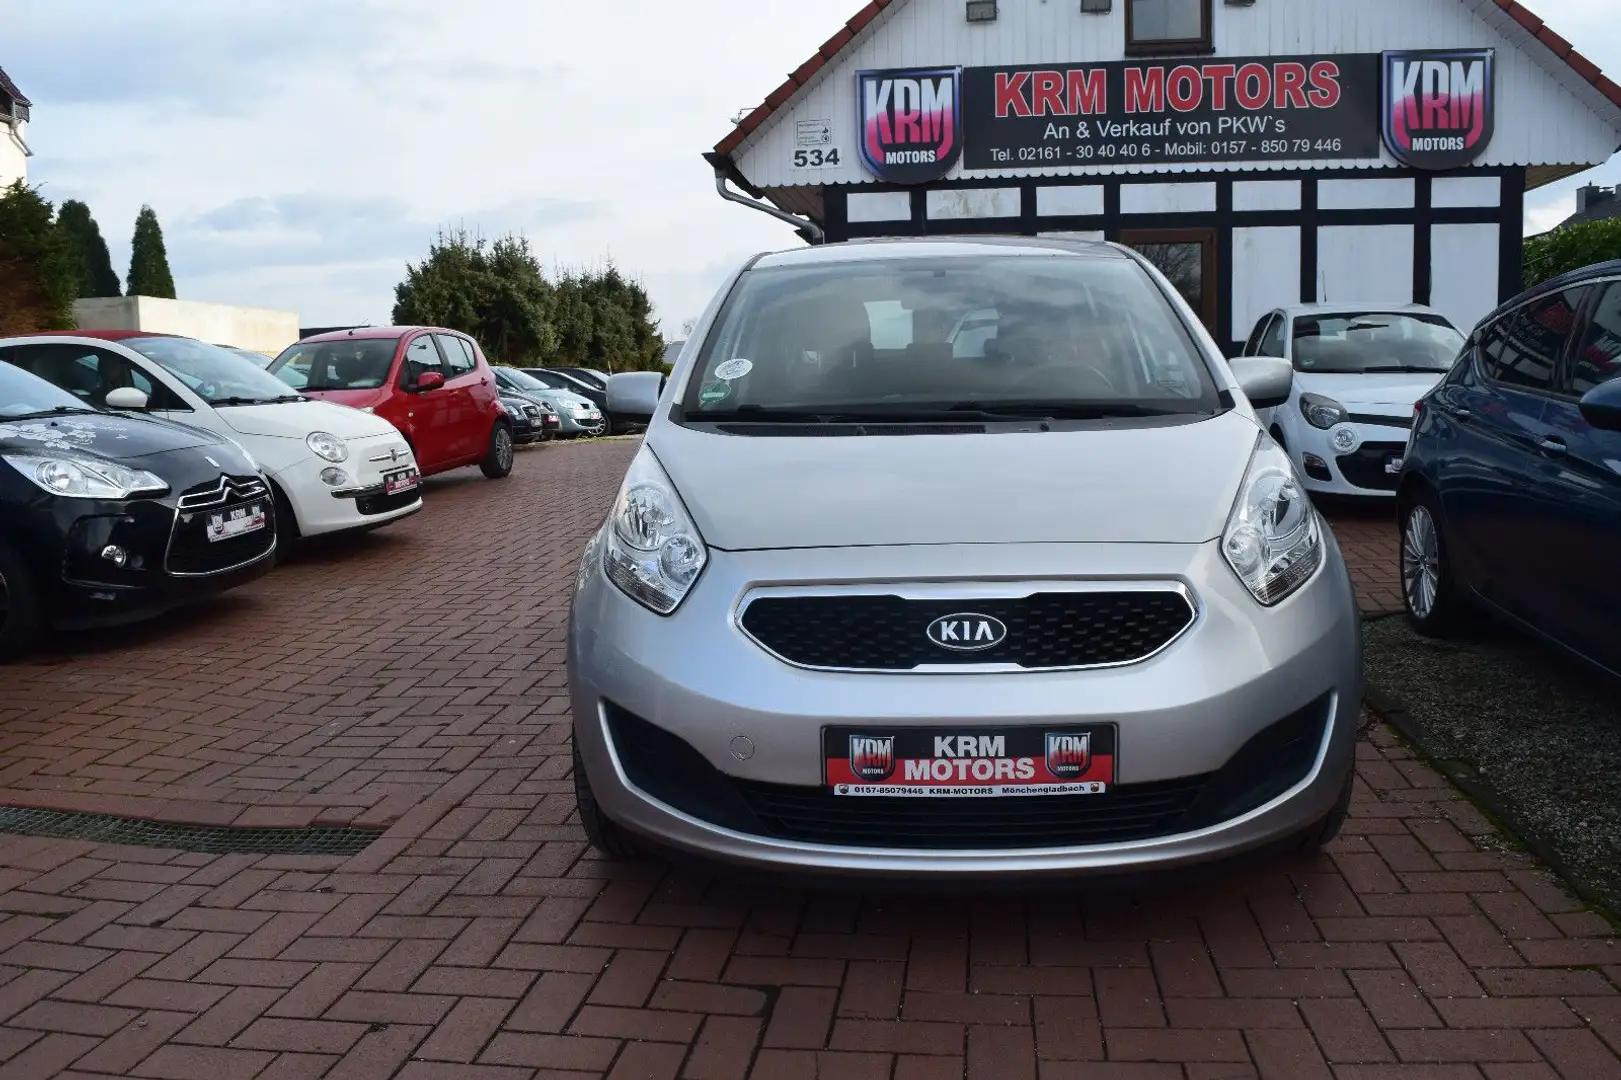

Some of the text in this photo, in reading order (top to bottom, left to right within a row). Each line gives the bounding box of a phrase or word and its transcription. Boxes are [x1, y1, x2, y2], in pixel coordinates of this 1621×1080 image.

[994, 61, 1341, 118] KRM MOTORS
[1393, 61, 1484, 149] KRM
[866, 78, 953, 161] KRM
[1043, 122, 1070, 140] An
[1076, 121, 1091, 139] &
[1097, 118, 1172, 138] Verkauf
[1176, 121, 1211, 136] von
[990, 147, 1014, 161] Tel.
[1018, 146, 1061, 161] 02161
[1076, 145, 1093, 159] 30
[1097, 144, 1116, 158] 40
[1120, 143, 1137, 157] 40
[1141, 143, 1150, 157] 6
[1165, 141, 1207, 156] Mobil:
[1211, 141, 1247, 155] 0157
[1261, 140, 1287, 153] 850
[1292, 139, 1310, 152] 79
[1314, 138, 1341, 151] 446
[1412, 137, 1464, 151] MOTORS
[794, 148, 840, 168] 534
[886, 150, 936, 164] MOTORS
[940, 621, 994, 641] KIA
[934, 736, 1005, 758] KRM
[904, 757, 1035, 780] MOTORS
[854, 784, 1085, 796] 0157-85079446 KRM-MOTORS Mönchengladbach
